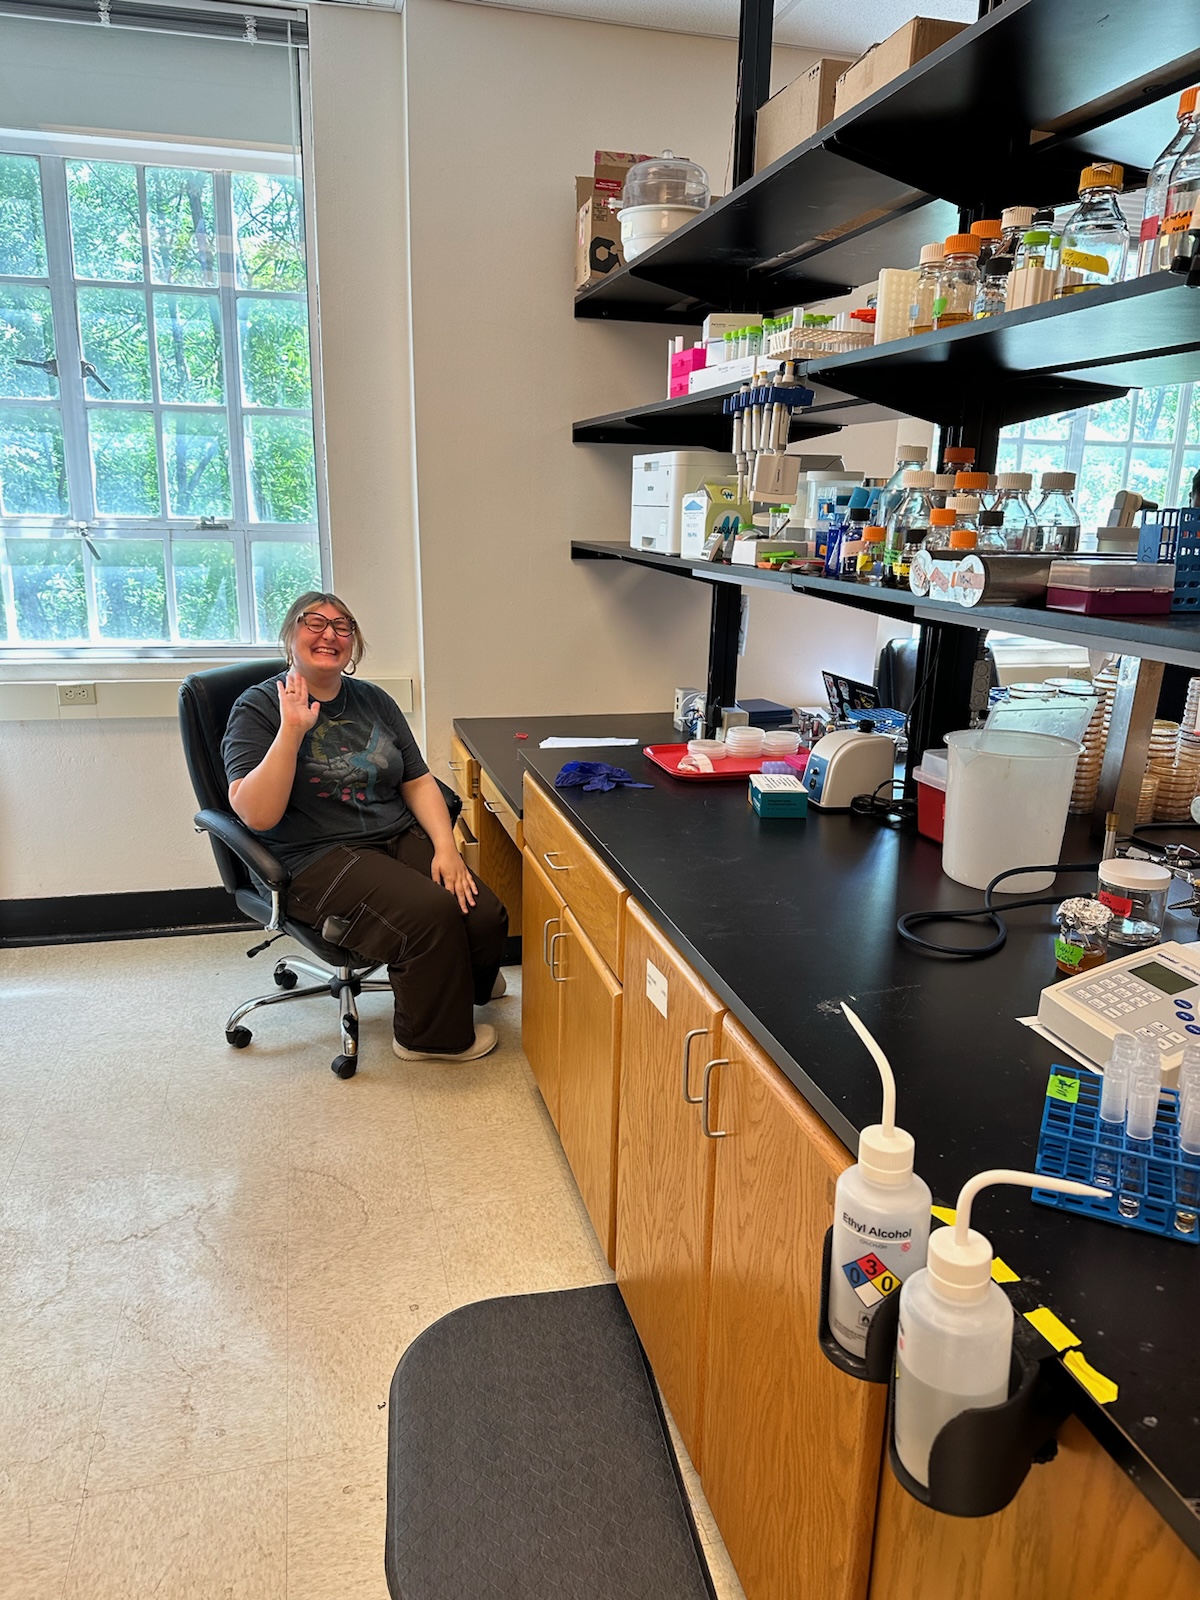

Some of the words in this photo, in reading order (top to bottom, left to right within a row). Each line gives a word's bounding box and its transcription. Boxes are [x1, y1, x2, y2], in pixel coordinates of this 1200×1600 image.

[843, 1212, 866, 1233] Ethyl
[868, 1227, 912, 1239] Alcohol
[865, 1259, 877, 1275] 3
[850, 1267, 860, 1284] 0
[881, 1276, 893, 1292] 0
